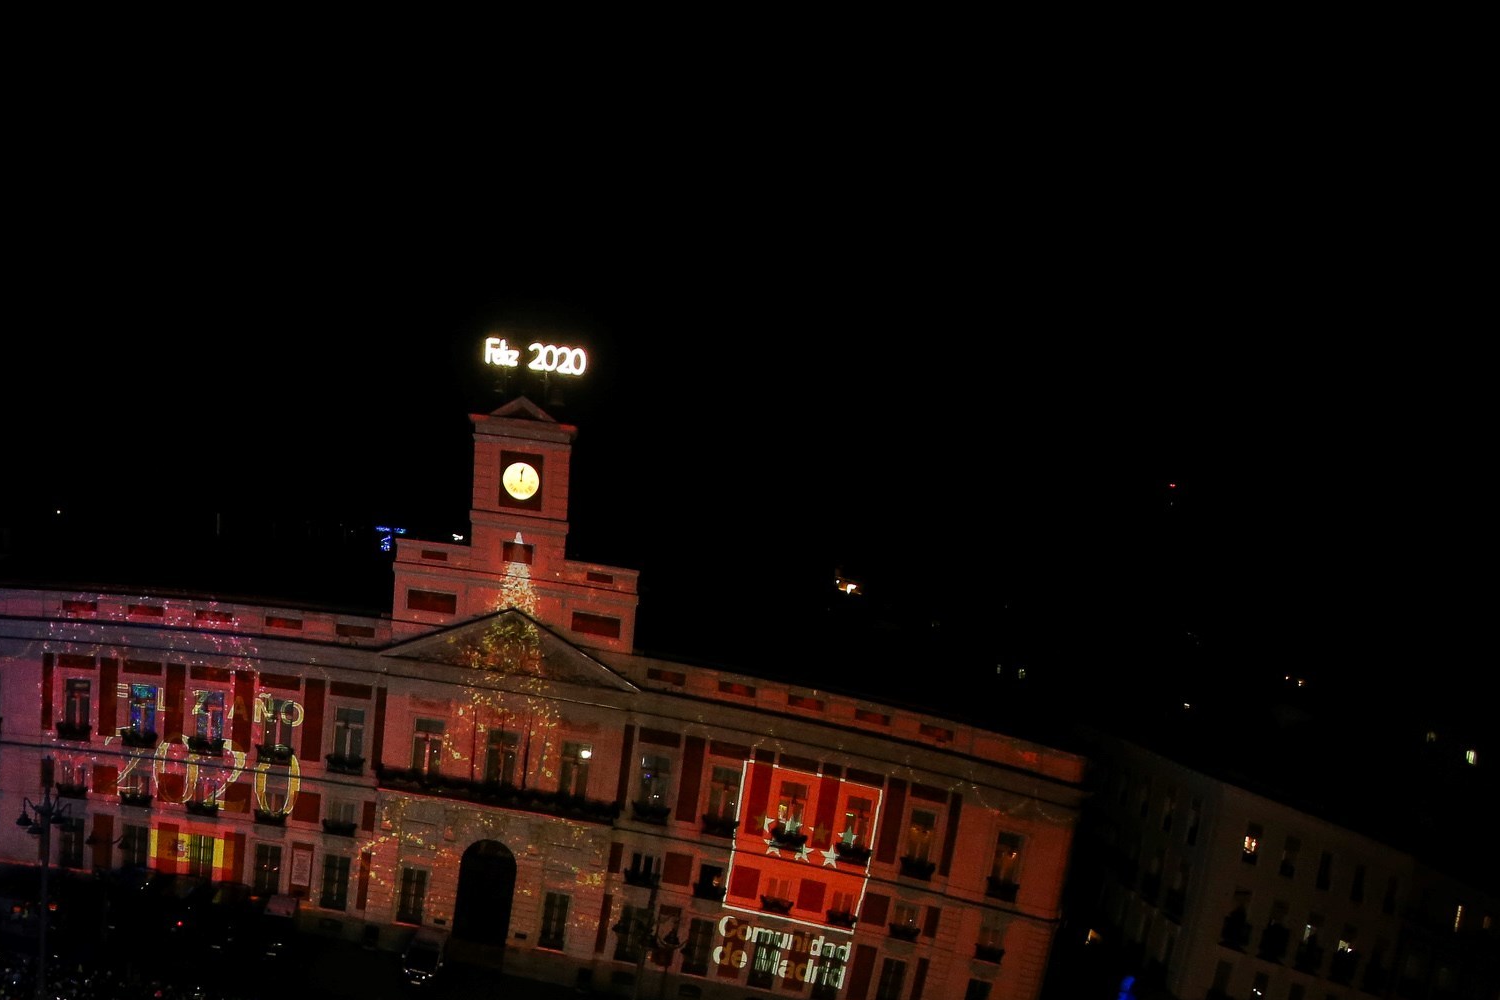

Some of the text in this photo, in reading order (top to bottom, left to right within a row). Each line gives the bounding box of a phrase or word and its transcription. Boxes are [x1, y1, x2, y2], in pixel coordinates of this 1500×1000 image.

[484, 337, 588, 376] Feliz 2020
[228, 692, 305, 727] AÑO
[104, 724, 302, 817] 2020
[718, 915, 853, 963] Comunidad
[713, 942, 847, 990] de Madrid
